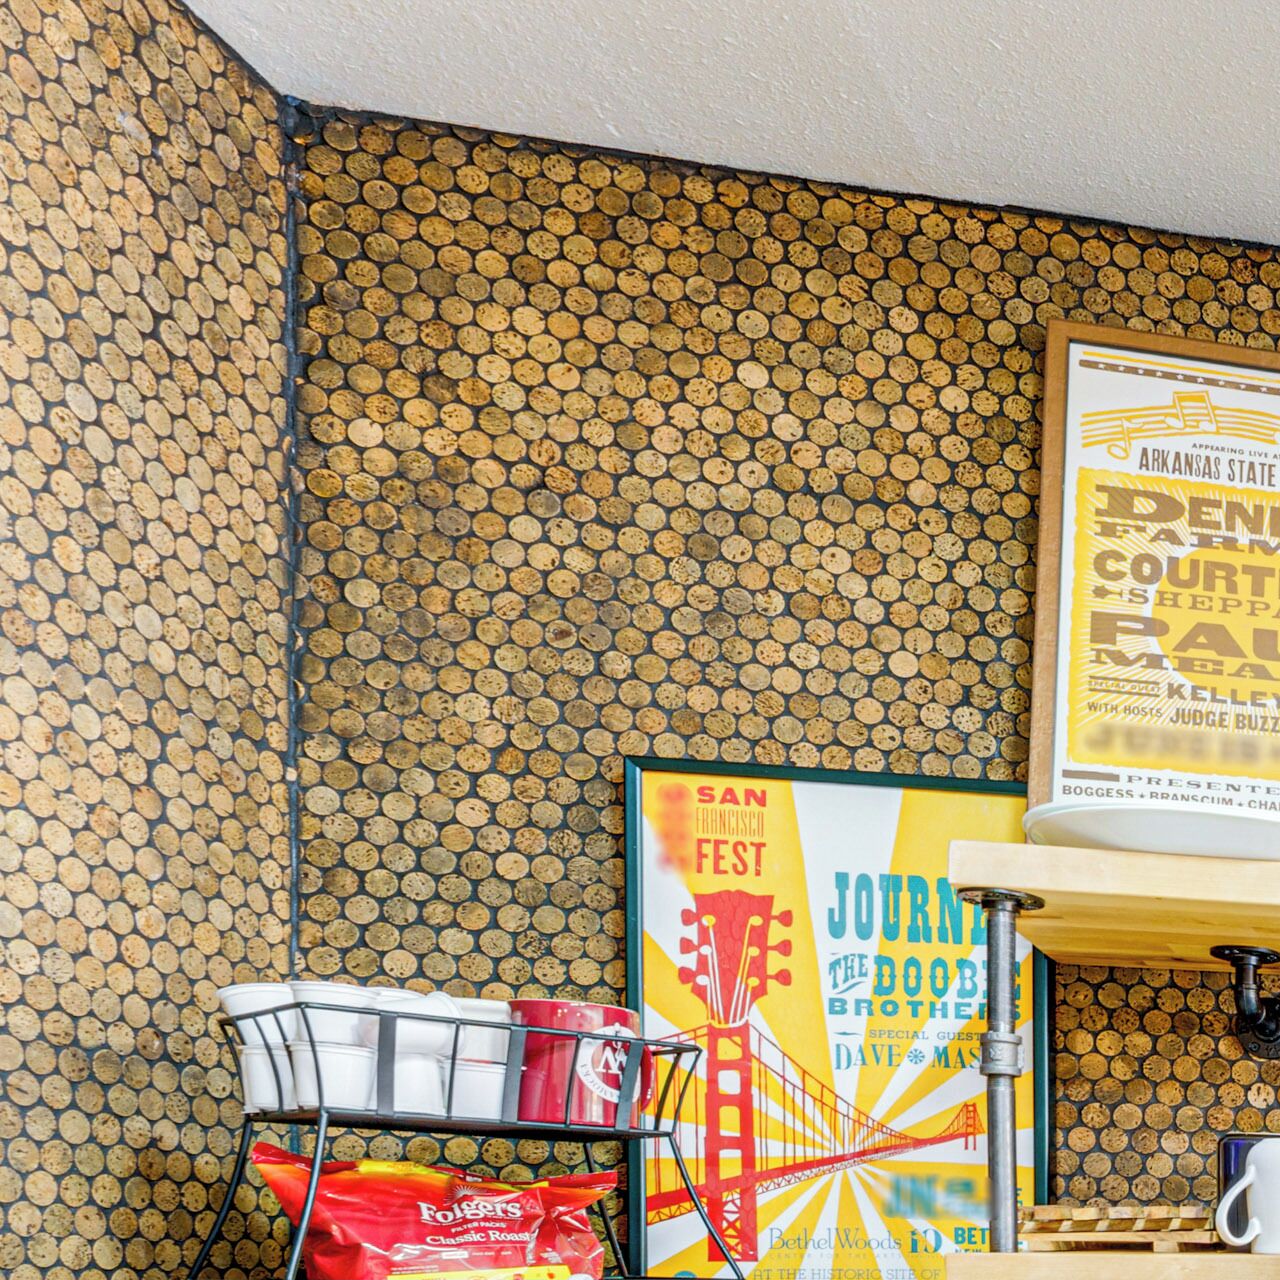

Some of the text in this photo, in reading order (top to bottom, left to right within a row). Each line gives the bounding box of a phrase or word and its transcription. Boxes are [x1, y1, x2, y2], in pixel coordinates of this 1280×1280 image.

[1192, 443, 1245, 455] APPEARING
[1249, 450, 1268, 458] LIVE
[1139, 447, 1221, 480] ARKANSAS
[1228, 459, 1276, 488] STATE
[1088, 702, 1118, 714] WITH
[1124, 706, 1163, 718] HOSTS
[1170, 707, 1228, 729] JUDGE
[1236, 715, 1280, 733] BUZZ
[697, 786, 766, 807] SAN
[1062, 785, 1134, 799] BOGGESS
[696, 808, 764, 838] FRANCISCO
[696, 838, 766, 877] FEST
[828, 953, 868, 990] THE
[869, 1029, 929, 1040] SPECIAL
[834, 1043, 901, 1070] DAVE
[417, 1199, 523, 1225] Folgers
[426, 1230, 486, 1245] Classic
[451, 1222, 479, 1233] FILTER
[753, 1268, 941, 1280] AT THE HISTORIC SITE OF
